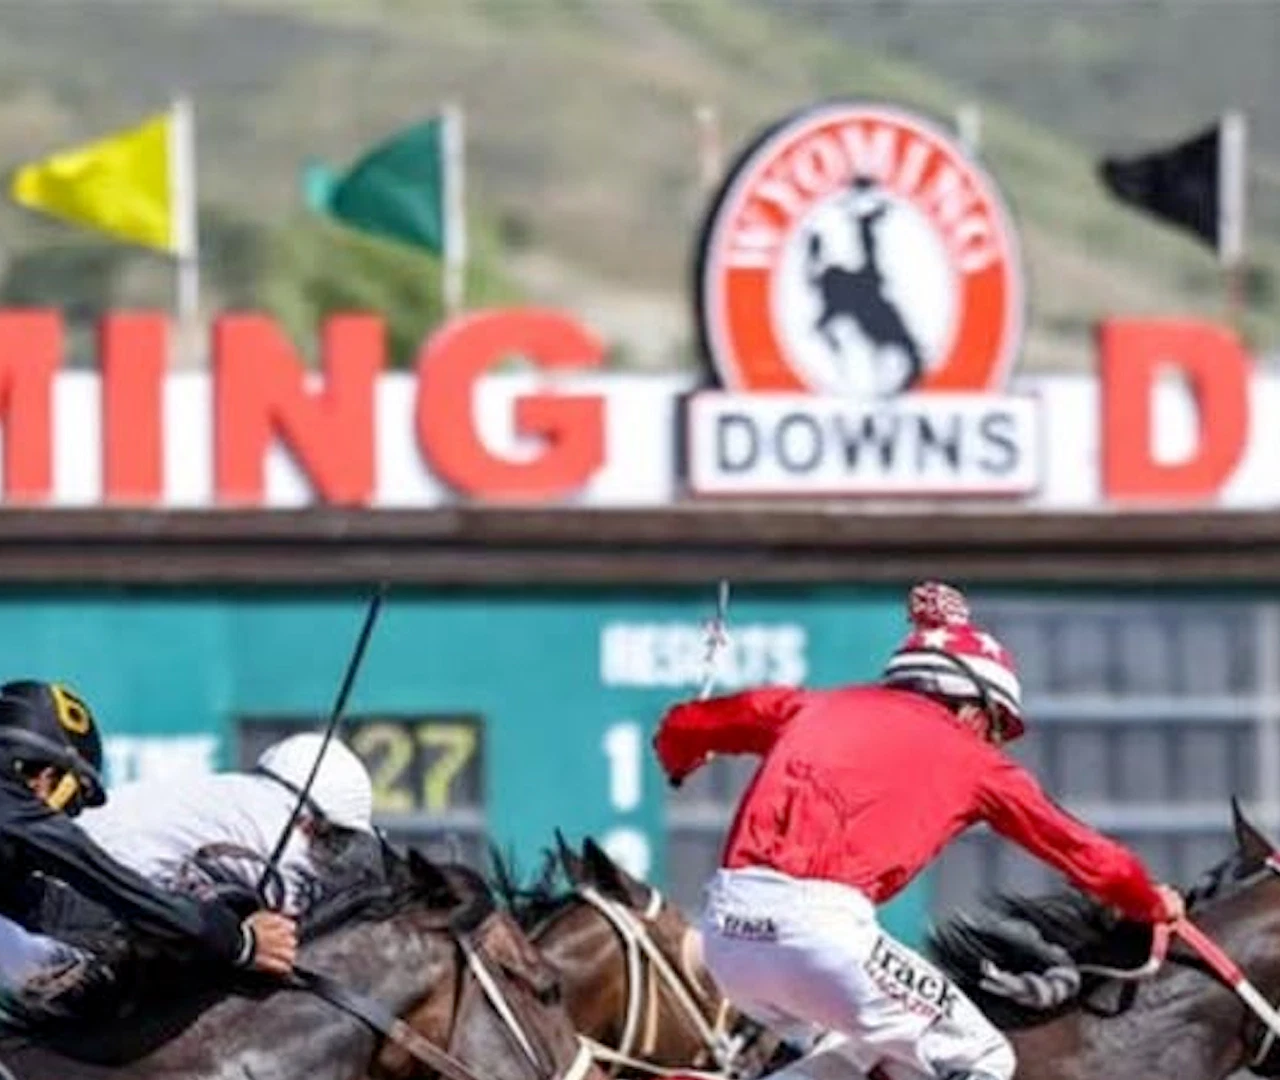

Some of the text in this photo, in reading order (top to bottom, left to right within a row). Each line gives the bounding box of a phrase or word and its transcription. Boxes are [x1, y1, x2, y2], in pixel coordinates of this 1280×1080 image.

[722, 120, 1001, 275] WYOMING
[717, 411, 1019, 475] DOWNS
[50, 682, 90, 735] 6
[605, 722, 642, 812] 1
[870, 936, 959, 1018] track
